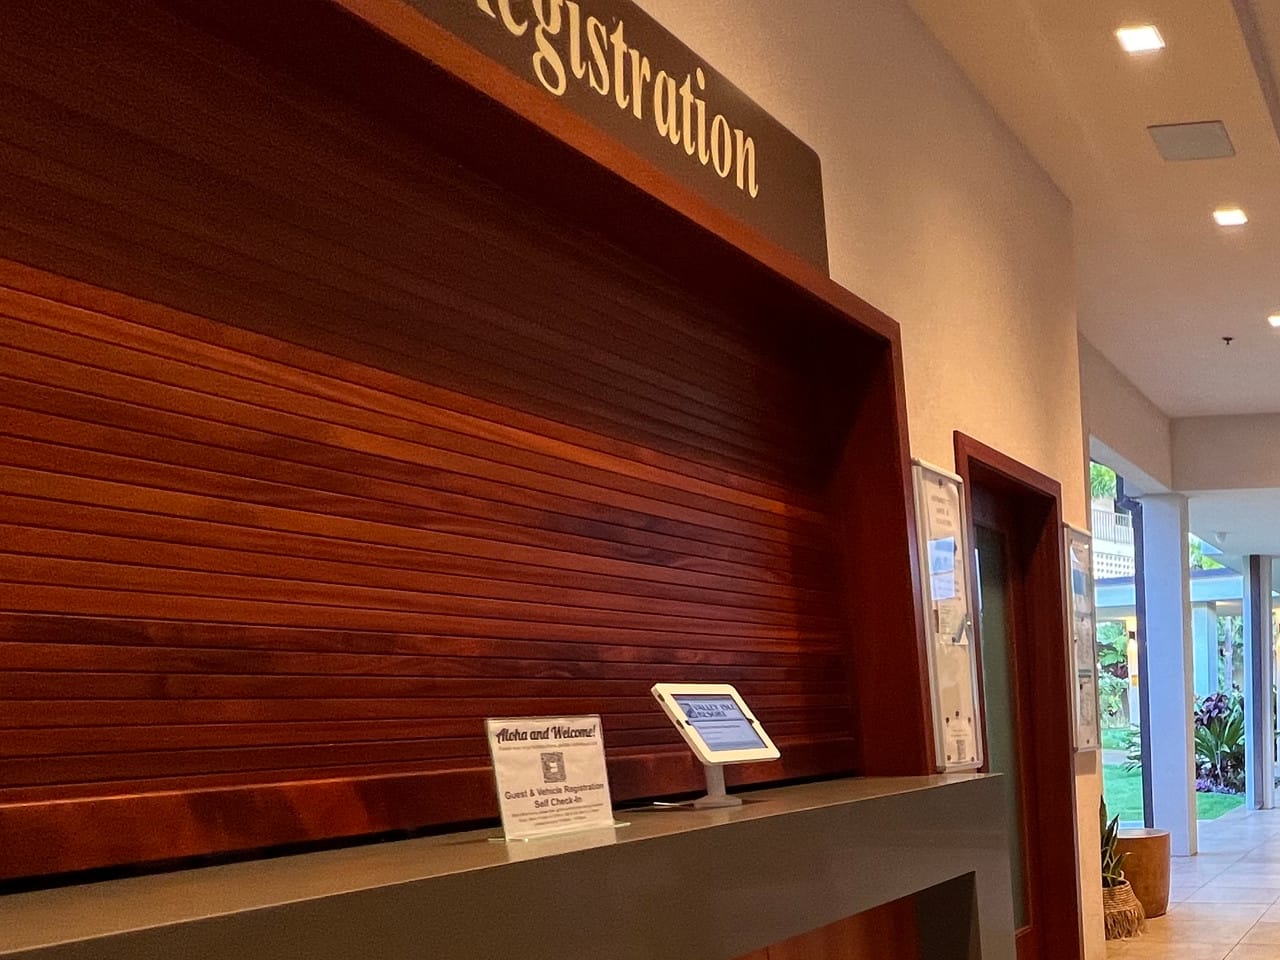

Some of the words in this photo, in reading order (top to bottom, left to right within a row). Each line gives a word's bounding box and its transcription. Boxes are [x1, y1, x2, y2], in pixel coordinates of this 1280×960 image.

[477, 0, 759, 199] gistration
[496, 727, 528, 744] Aloha
[530, 727, 549, 741] and
[551, 724, 596, 740] Welcome!
[504, 789, 529, 800] Guest
[530, 789, 535, 797] &
[536, 786, 563, 796] Vehicle
[564, 783, 604, 794] Registration
[535, 799, 549, 808] Self
